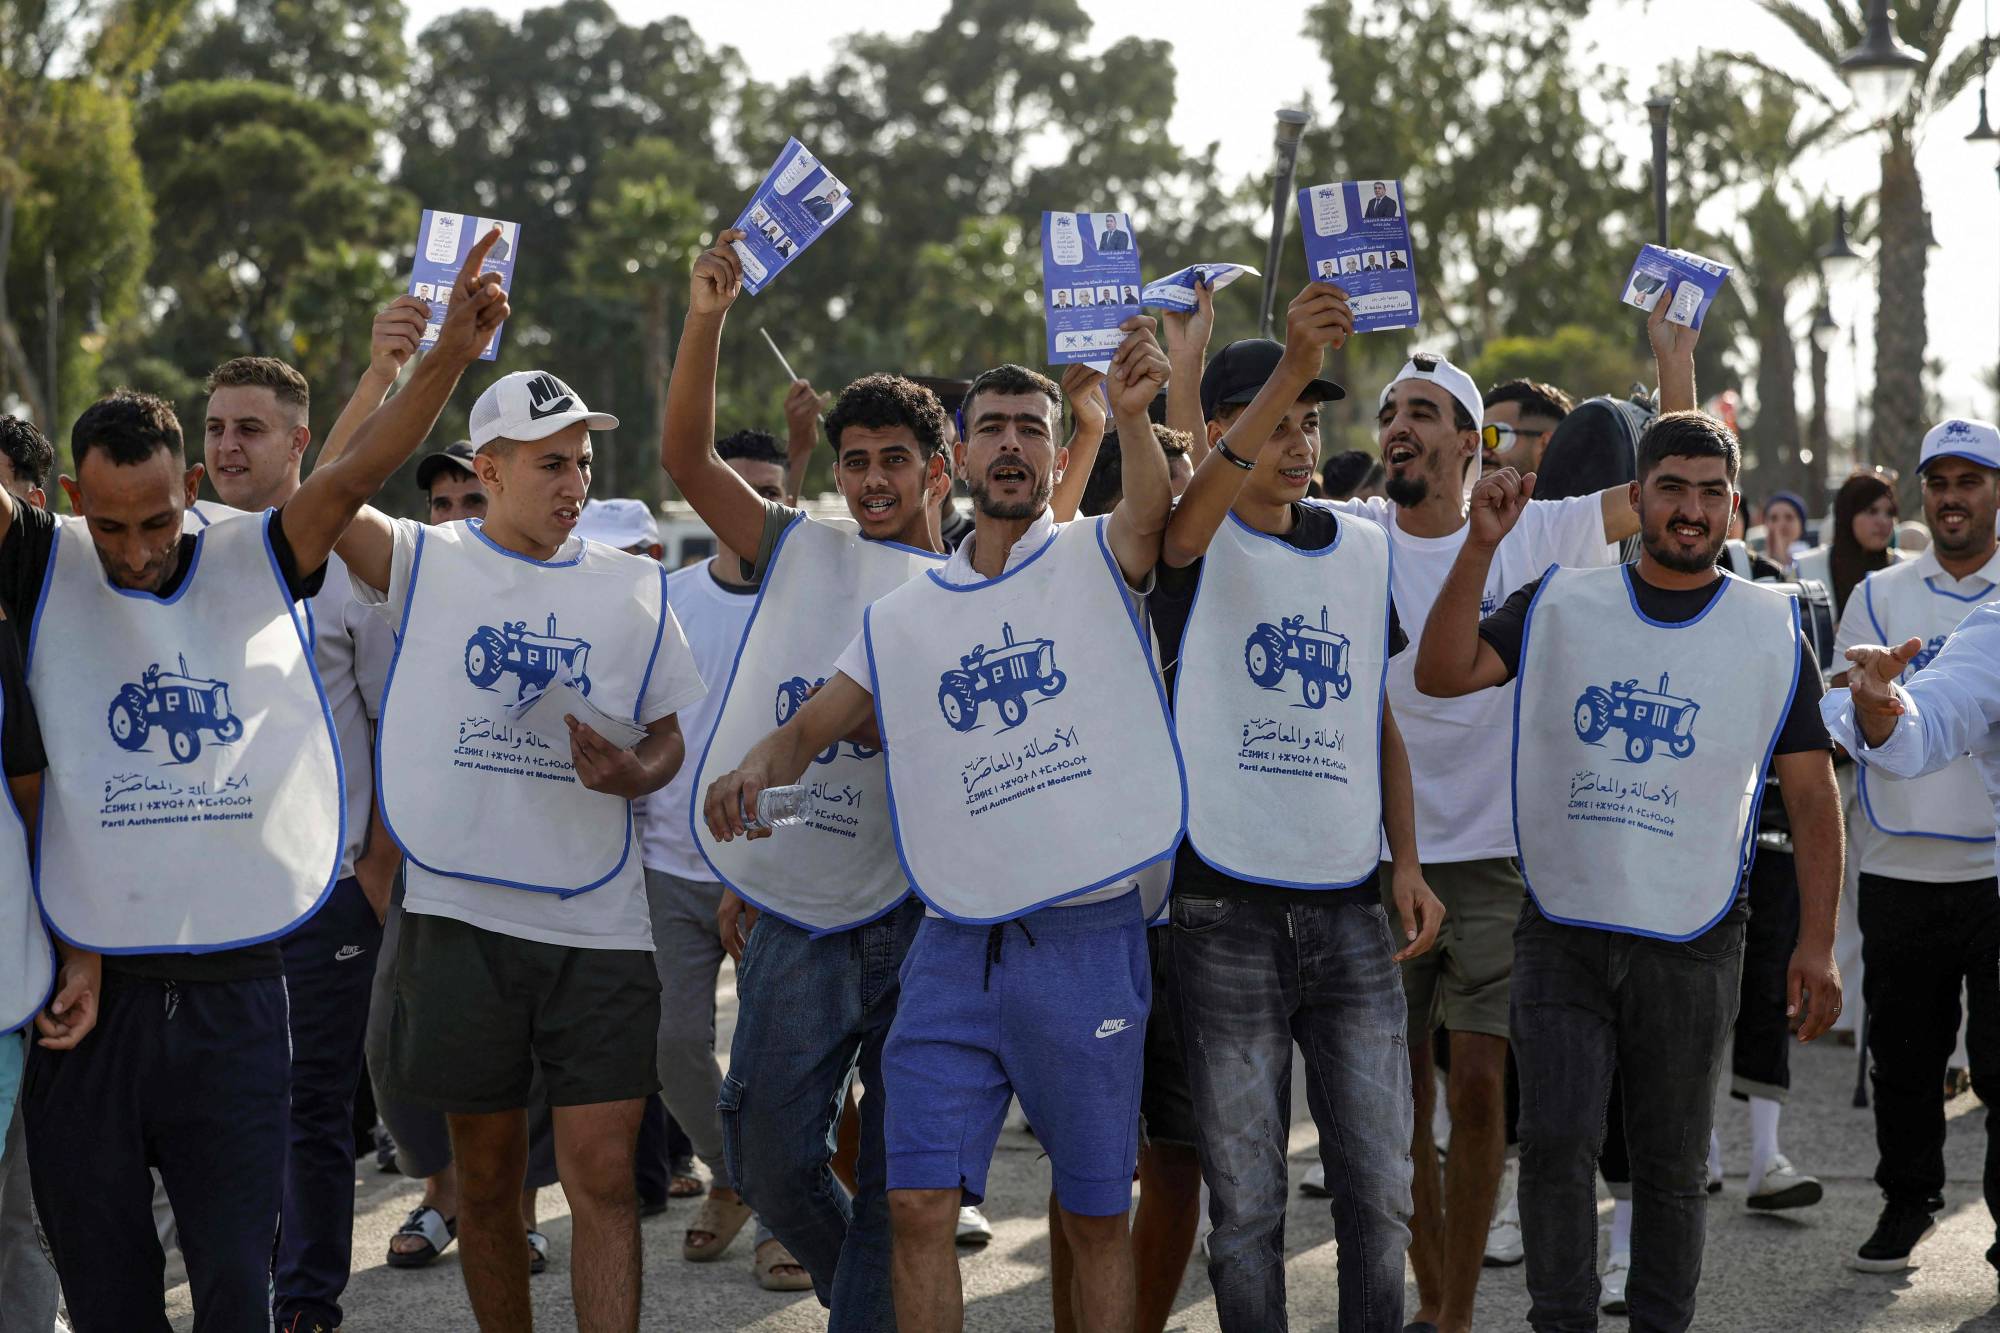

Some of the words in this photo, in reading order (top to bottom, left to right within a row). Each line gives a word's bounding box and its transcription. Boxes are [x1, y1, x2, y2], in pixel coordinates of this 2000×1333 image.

[467, 716, 491, 727] حزب
[1250, 718, 1277, 730] حزب
[460, 721, 521, 749] والمعاصرة
[1023, 725, 1079, 759] الأصالة
[1243, 723, 1311, 749] والمعاصرة
[454, 759, 473, 769] Parti
[474, 762, 525, 776] Authenticité
[535, 771, 576, 783] Modernité
[961, 751, 1023, 794] والمعاصرة
[964, 756, 987, 771] حزب
[1238, 762, 1258, 772] Parti
[1260, 764, 1313, 778] Authenticité
[1576, 770, 1596, 781] حزب
[105, 776, 182, 802] والمعاصرة
[113, 773, 142, 783] حزب
[1570, 774, 1627, 799] والمعاصرة
[810, 782, 863, 808] الأصالة
[970, 805, 988, 817] Parti
[989, 785, 1036, 809] Authenticité
[1036, 782, 1046, 790] et
[1047, 768, 1093, 787] Modernité
[1630, 781, 1679, 808] الأصالة
[101, 819, 125, 828] Parti
[127, 815, 188, 826] Authenticité
[204, 812, 253, 821] Modernité
[815, 822, 856, 838] Modernité
[1581, 814, 1626, 824] Authenticité
[1637, 821, 1674, 838] Modernité
[340, 945, 360, 955] NIKE
[1101, 1018, 1125, 1031] NIKE
